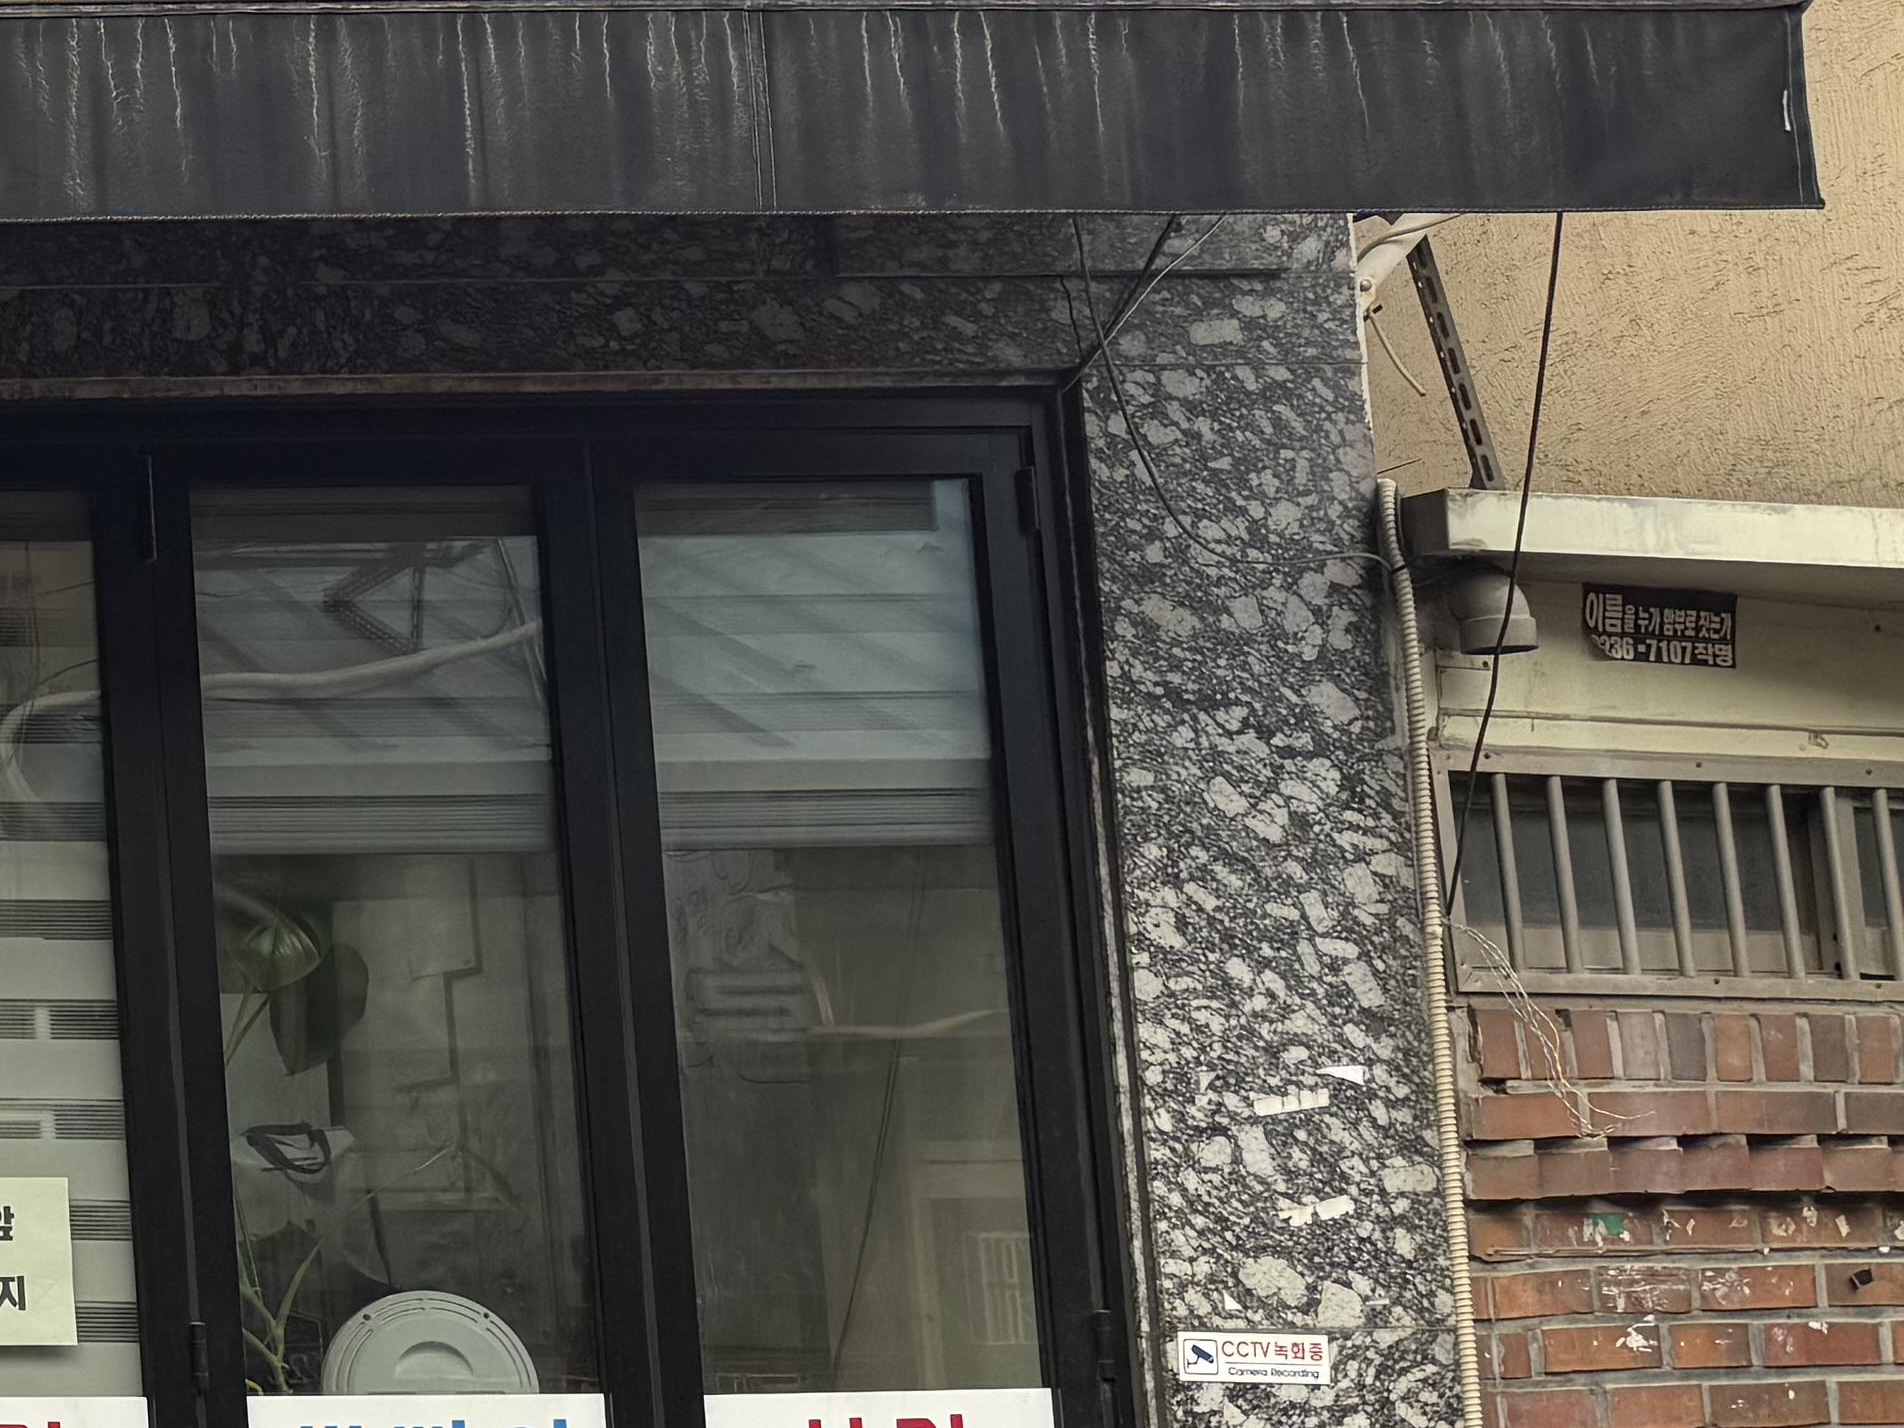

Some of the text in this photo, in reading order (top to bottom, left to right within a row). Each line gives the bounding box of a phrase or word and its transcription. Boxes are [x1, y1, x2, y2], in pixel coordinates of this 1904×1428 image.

[1638, 606, 1660, 635] 누가
[1592, 634, 1692, 664] 236-7107
[1228, 1367, 1320, 1380] Camera Recording
